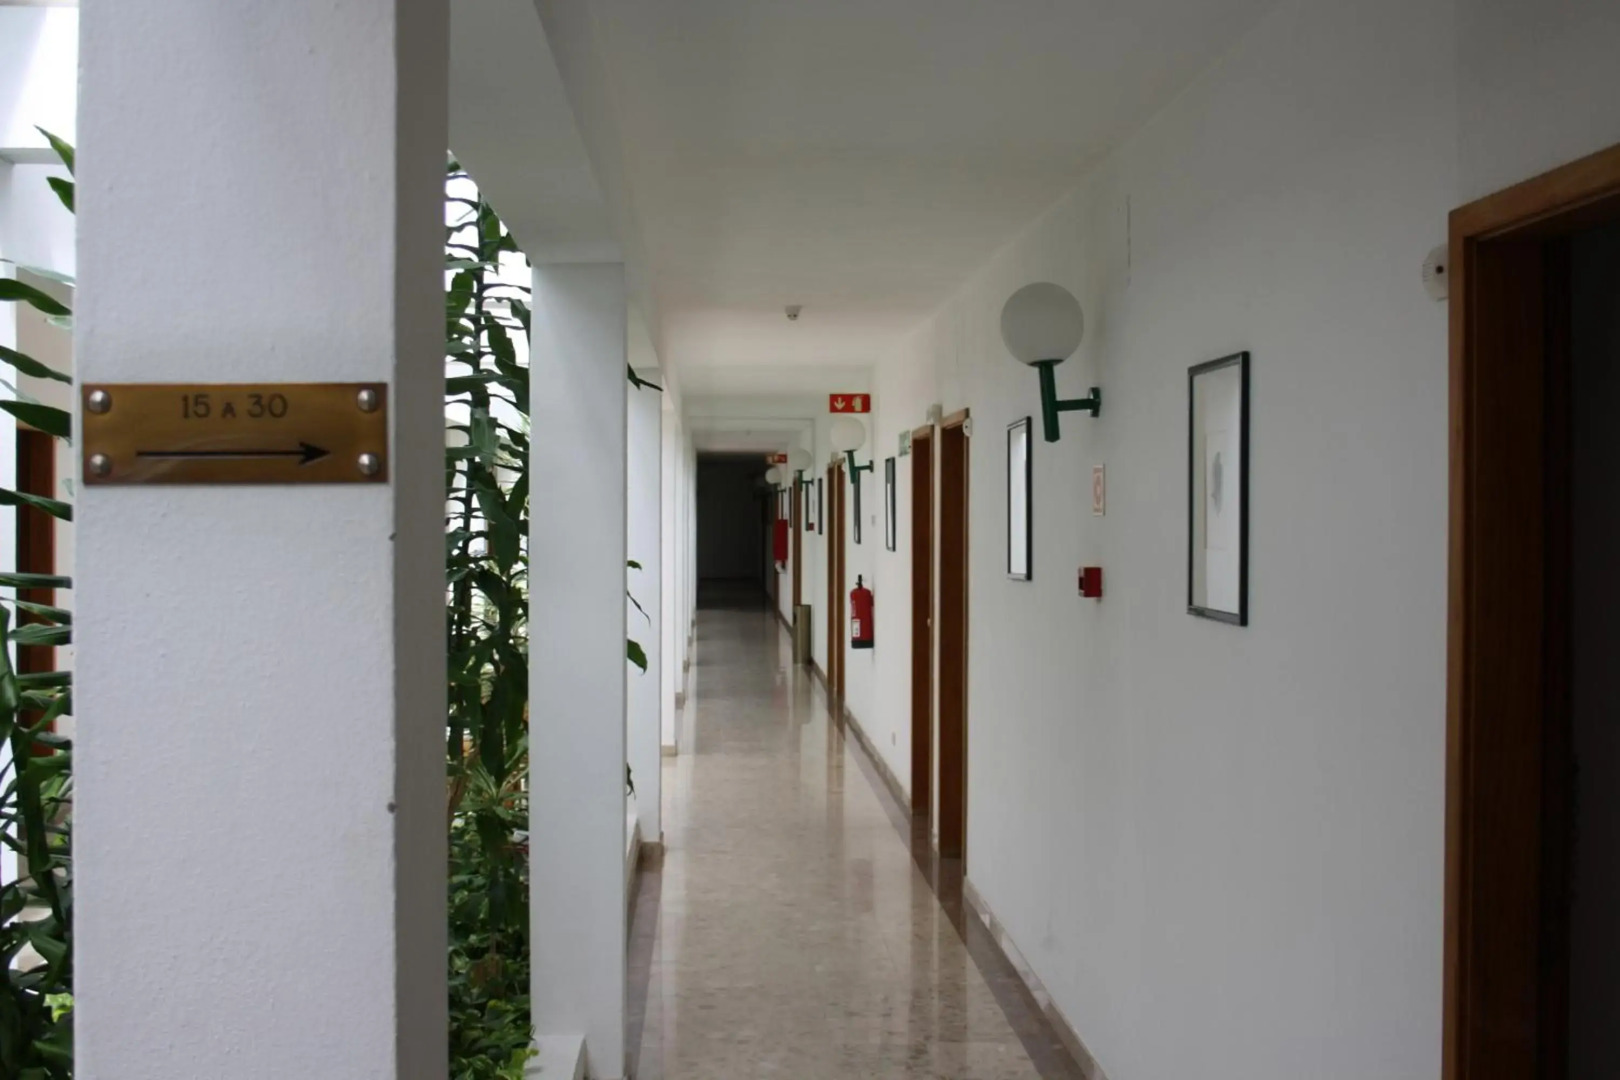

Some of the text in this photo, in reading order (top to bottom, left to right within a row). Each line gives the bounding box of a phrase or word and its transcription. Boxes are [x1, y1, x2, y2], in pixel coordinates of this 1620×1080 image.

[181, 393, 288, 419] 15 A 30
